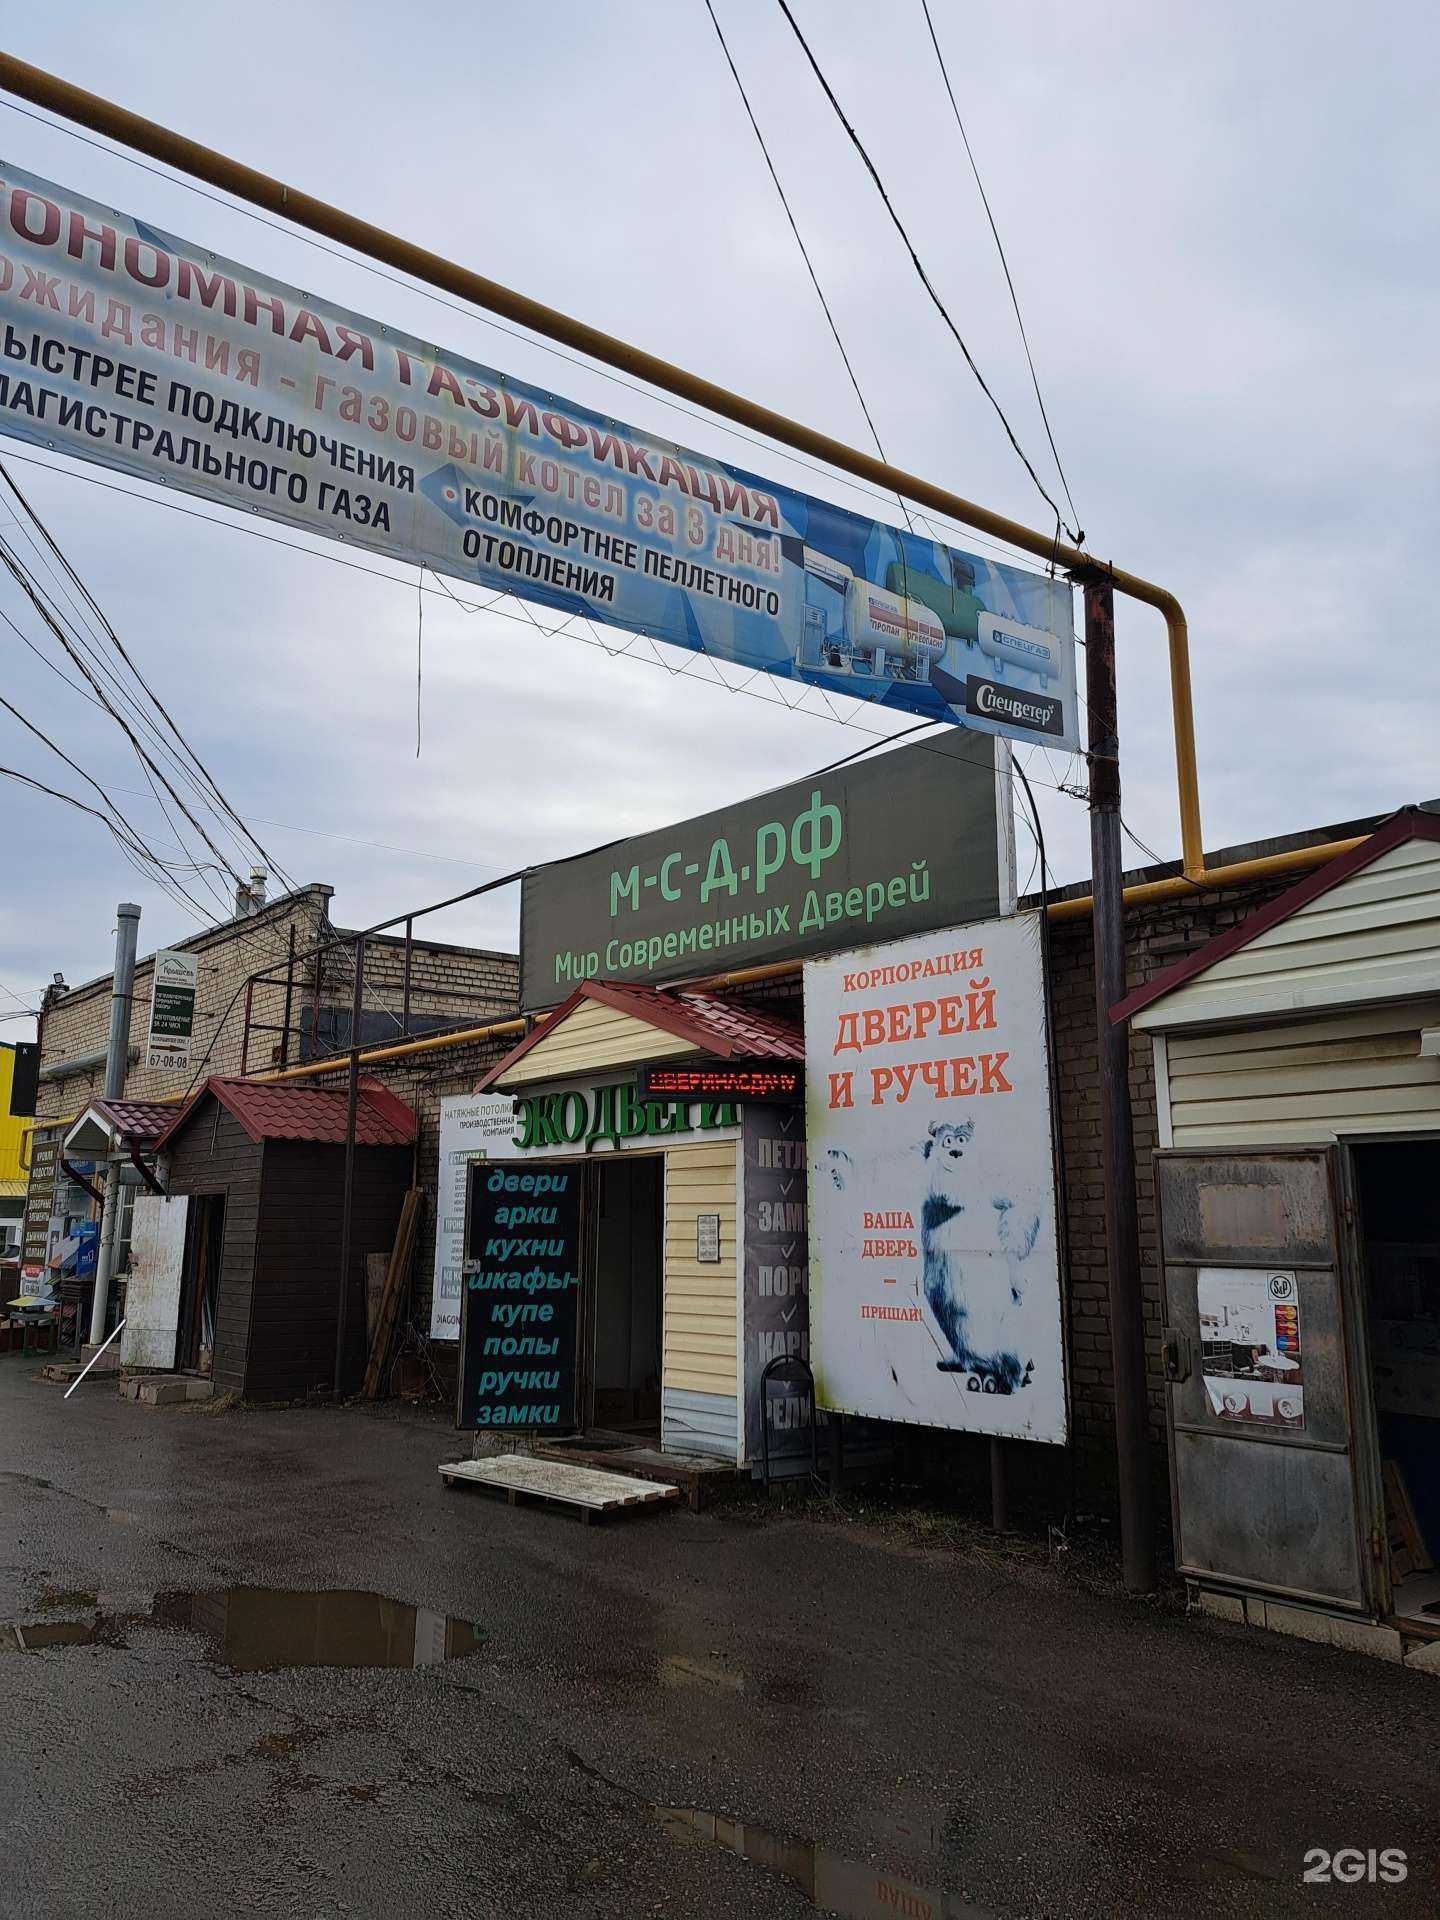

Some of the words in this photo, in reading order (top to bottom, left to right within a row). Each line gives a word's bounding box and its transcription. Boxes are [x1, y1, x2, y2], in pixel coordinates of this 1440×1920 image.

[0, 179, 374, 371] ОНОМНАЯ
[394, 349, 779, 529] ГАЗИФИКАЦИЯ
[0, 325, 158, 405] ЫСТРЕЕ
[168, 381, 415, 493] ПОДКЛЮЧЕНИЯ
[314, 375, 503, 473] газовый
[518, 448, 624, 518] котел
[637, 496, 675, 536] за
[687, 508, 704, 546] 3
[716, 526, 782, 573] дня!
[318, 482, 391, 532] ГАЗА
[462, 529, 616, 602] ОТОПЛЕНИЯ
[464, 487, 637, 569] КОМФОРТНЕЕ
[643, 549, 779, 615] ПЕЛЛЕТНОГО
[555, 950, 599, 984] Мир
[605, 904, 790, 971] Современных
[799, 859, 931, 934] Дверей
[843, 948, 984, 993] КОРПОРАЦИЯ
[833, 976, 998, 1056] ДВЕРЕЙ
[150, 1054, 187, 1068] 67-08-08
[828, 1071, 855, 1109] И
[871, 1052, 1013, 1105] РУЧЕК
[444, 1107, 480, 1120] НАТЯЖНЫЕ
[758, 1139, 806, 1169] ПЕТЛ
[487, 1168, 568, 1197] двери
[494, 1205, 558, 1229] арки
[758, 1201, 807, 1232] ЗАМ
[863, 1211, 914, 1229] ВАША
[485, 1239, 564, 1262] кухни
[861, 1239, 917, 1260] ДВЕРЬ
[468, 1266, 579, 1295] шкафы-
[1273, 1280, 1288, 1295] S&P
[491, 1304, 554, 1326] купе
[483, 1337, 560, 1356] полы
[478, 1370, 561, 1396] ручки
[476, 1404, 561, 1425] замки
